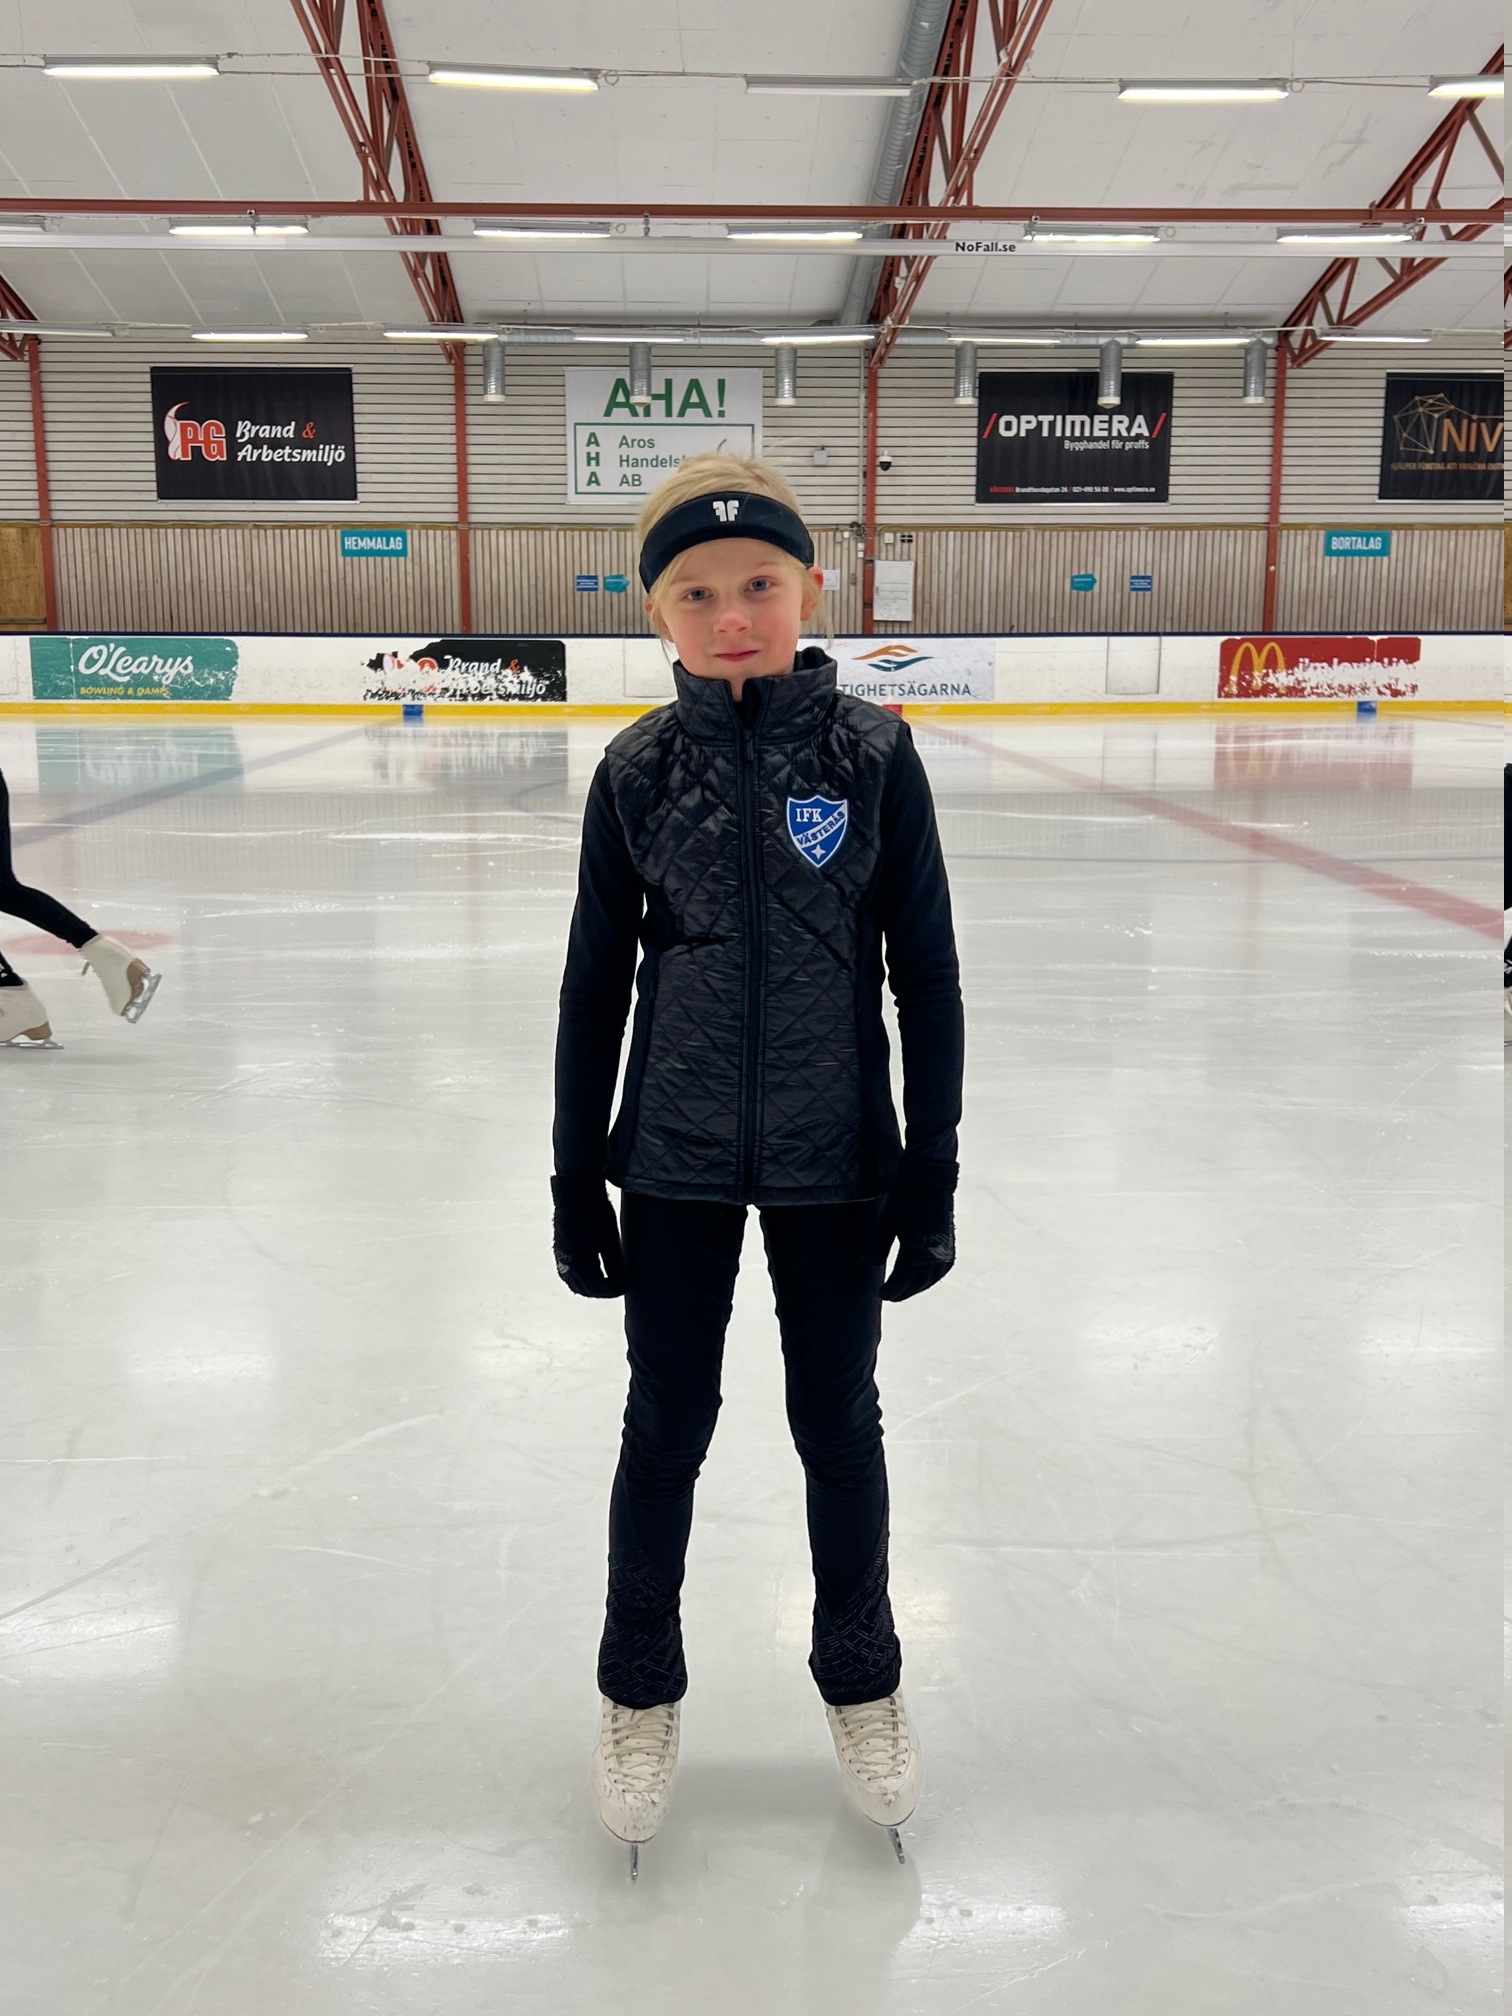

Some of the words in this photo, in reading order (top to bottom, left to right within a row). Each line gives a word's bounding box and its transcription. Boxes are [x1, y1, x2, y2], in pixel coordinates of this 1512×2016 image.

[955, 241, 1016, 252] NoFall.se
[603, 377, 726, 418] AHA!
[235, 420, 296, 442] Brand
[302, 421, 316, 439] &
[585, 432, 601, 448] A
[618, 435, 655, 449] Aros
[1064, 440, 1110, 452] Bygghandel
[236, 444, 346, 466] Arbetsmiljö
[586, 452, 601, 467] H
[619, 454, 687, 468] Handels
[586, 472, 601, 487] A
[619, 474, 642, 487] AB
[344, 536, 403, 550] HEMMALAG
[1331, 536, 1382, 550] BORTALAG
[78, 642, 194, 685] O'Learys
[79, 687, 125, 696] BOWLING
[795, 807, 823, 822] IFK
[797, 811, 845, 845] VÄSTERÅS
